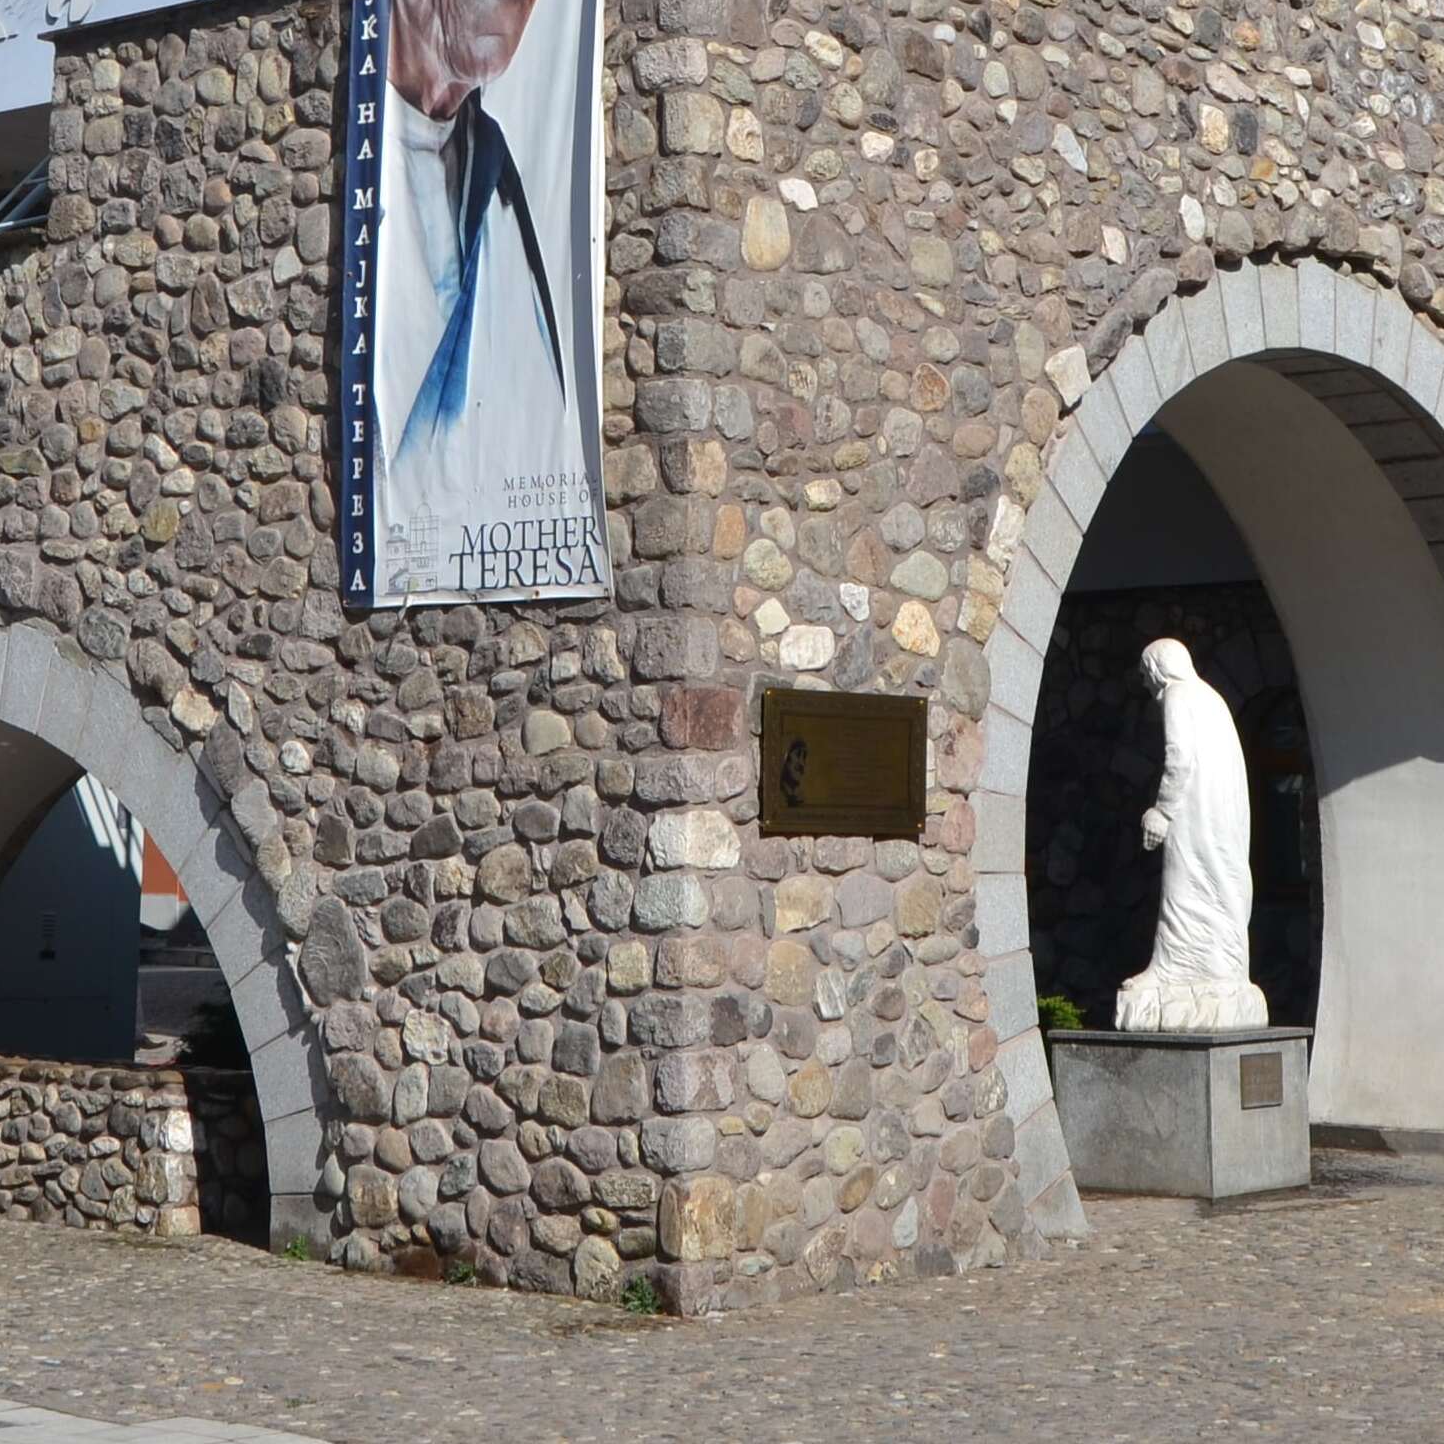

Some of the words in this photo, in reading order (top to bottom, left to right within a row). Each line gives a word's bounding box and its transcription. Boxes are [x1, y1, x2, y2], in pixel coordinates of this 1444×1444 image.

[356, 101, 377, 161] НА
[351, 186, 374, 356] МАЈКА
[349, 383, 367, 591] ТЕРЕЗА
[508, 492, 567, 508] HOUSE
[461, 516, 602, 554] MOTHER
[448, 543, 604, 592] TERESA
